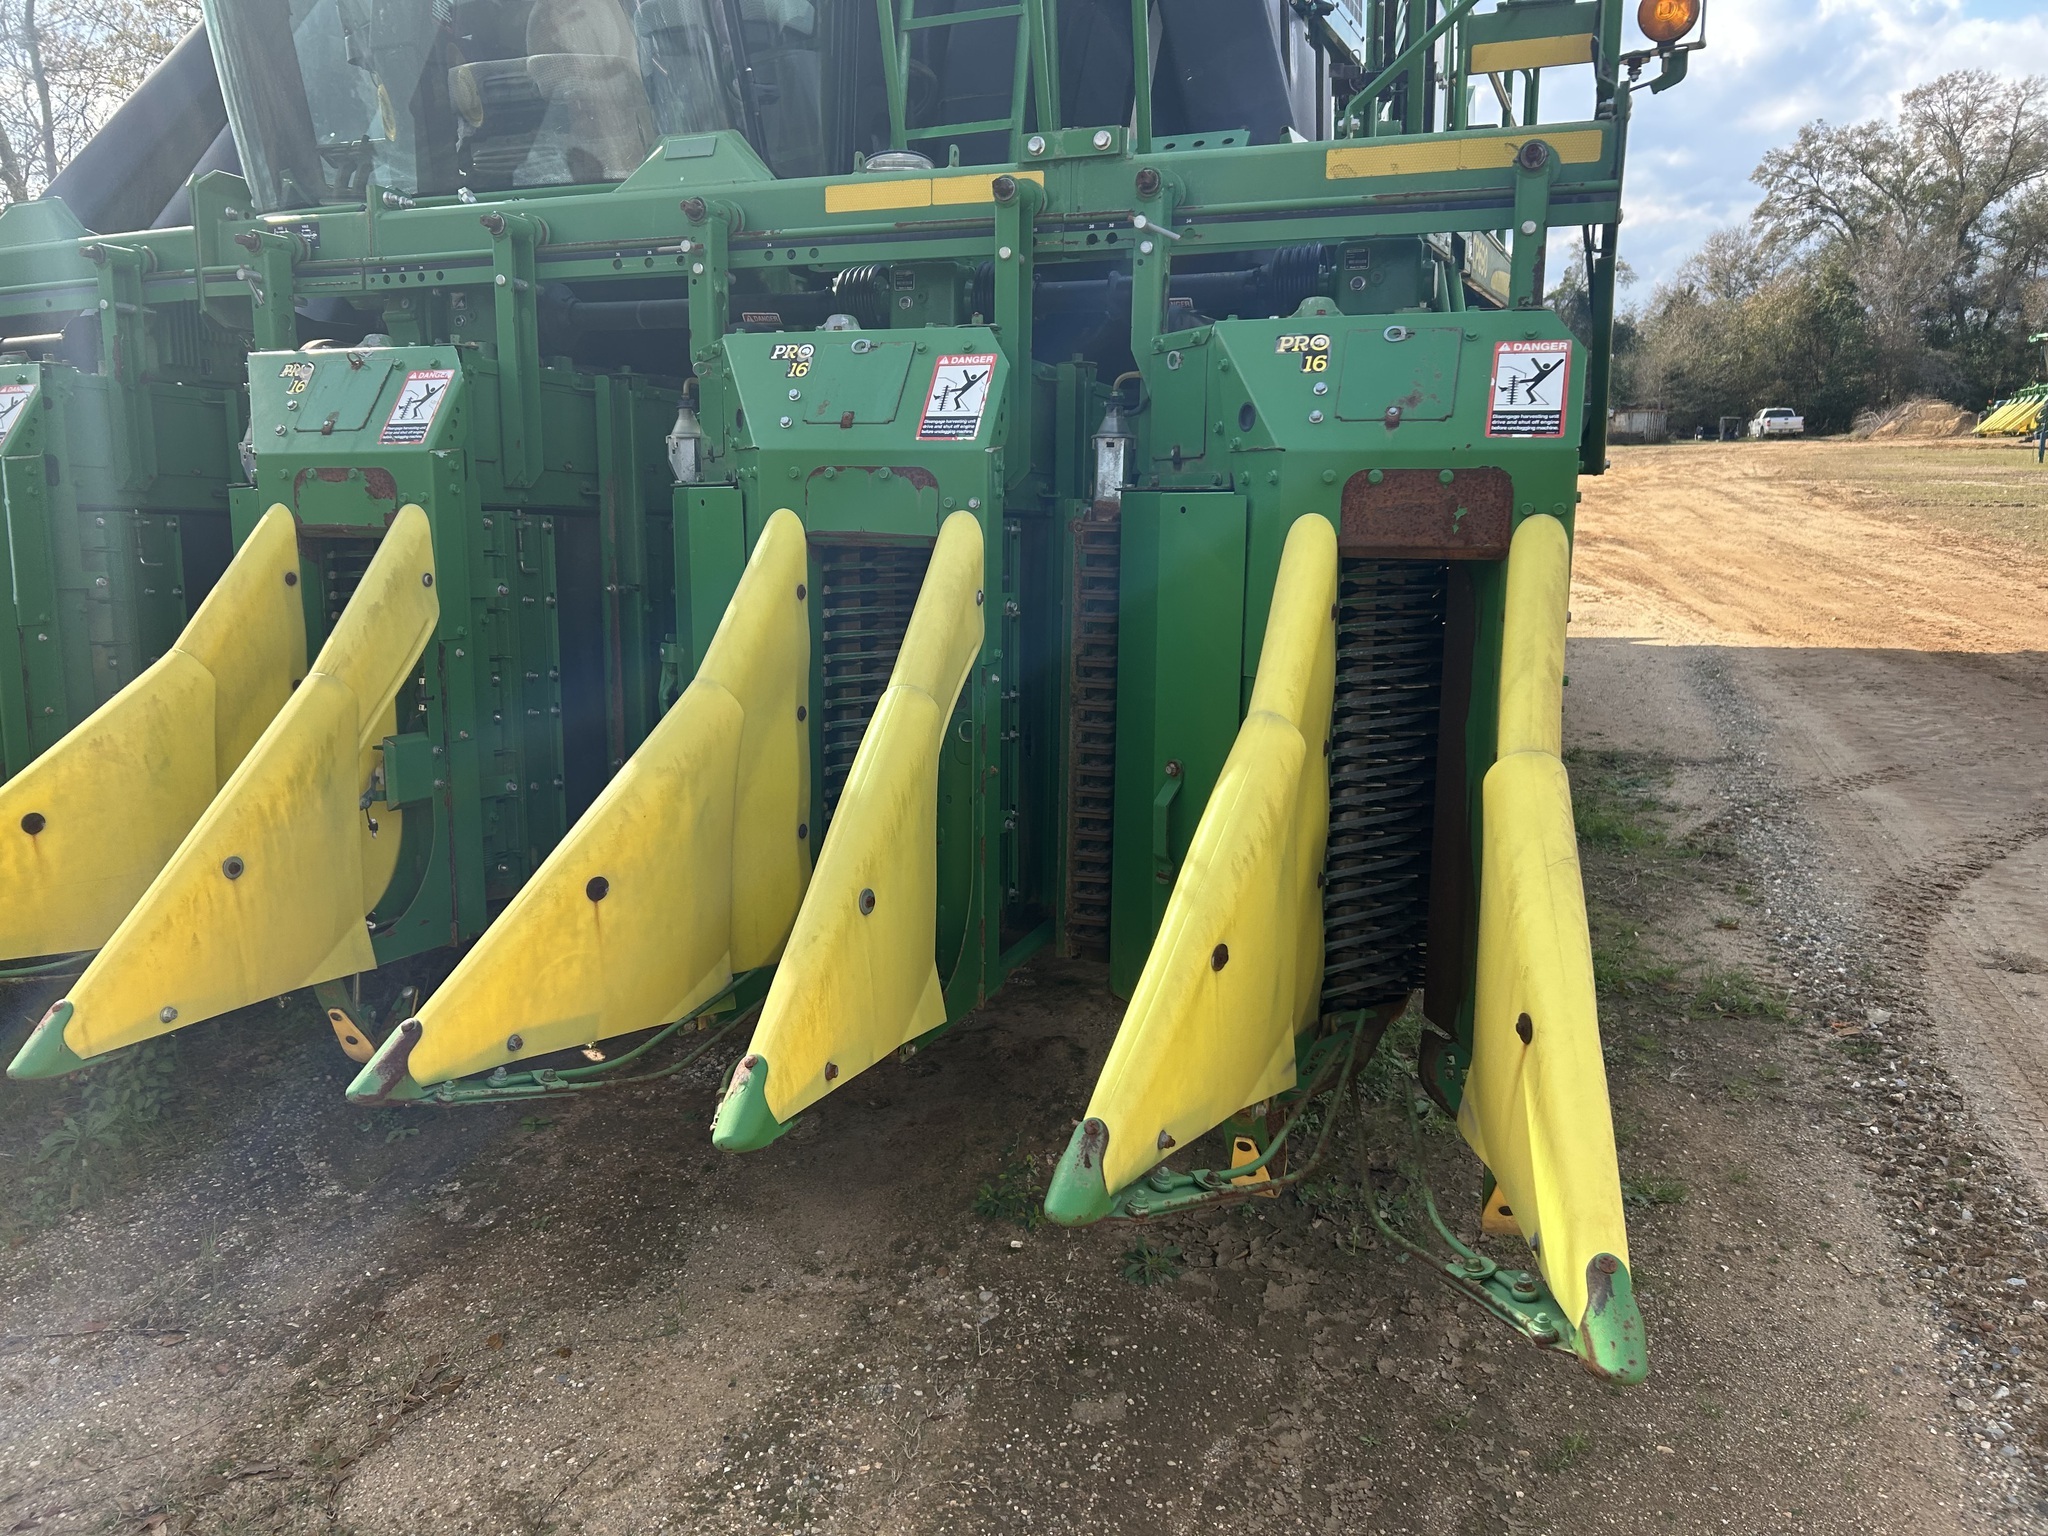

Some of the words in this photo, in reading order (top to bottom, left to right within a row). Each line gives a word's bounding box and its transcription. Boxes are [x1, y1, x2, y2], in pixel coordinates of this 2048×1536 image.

[1277, 334, 1330, 352] PRO
[1513, 342, 1568, 351] DANGER
[770, 344, 814, 359] PRO
[951, 355, 994, 364] DANGER
[1303, 354, 1328, 372] 16
[787, 362, 809, 377] 16
[290, 379, 305, 393] 16
